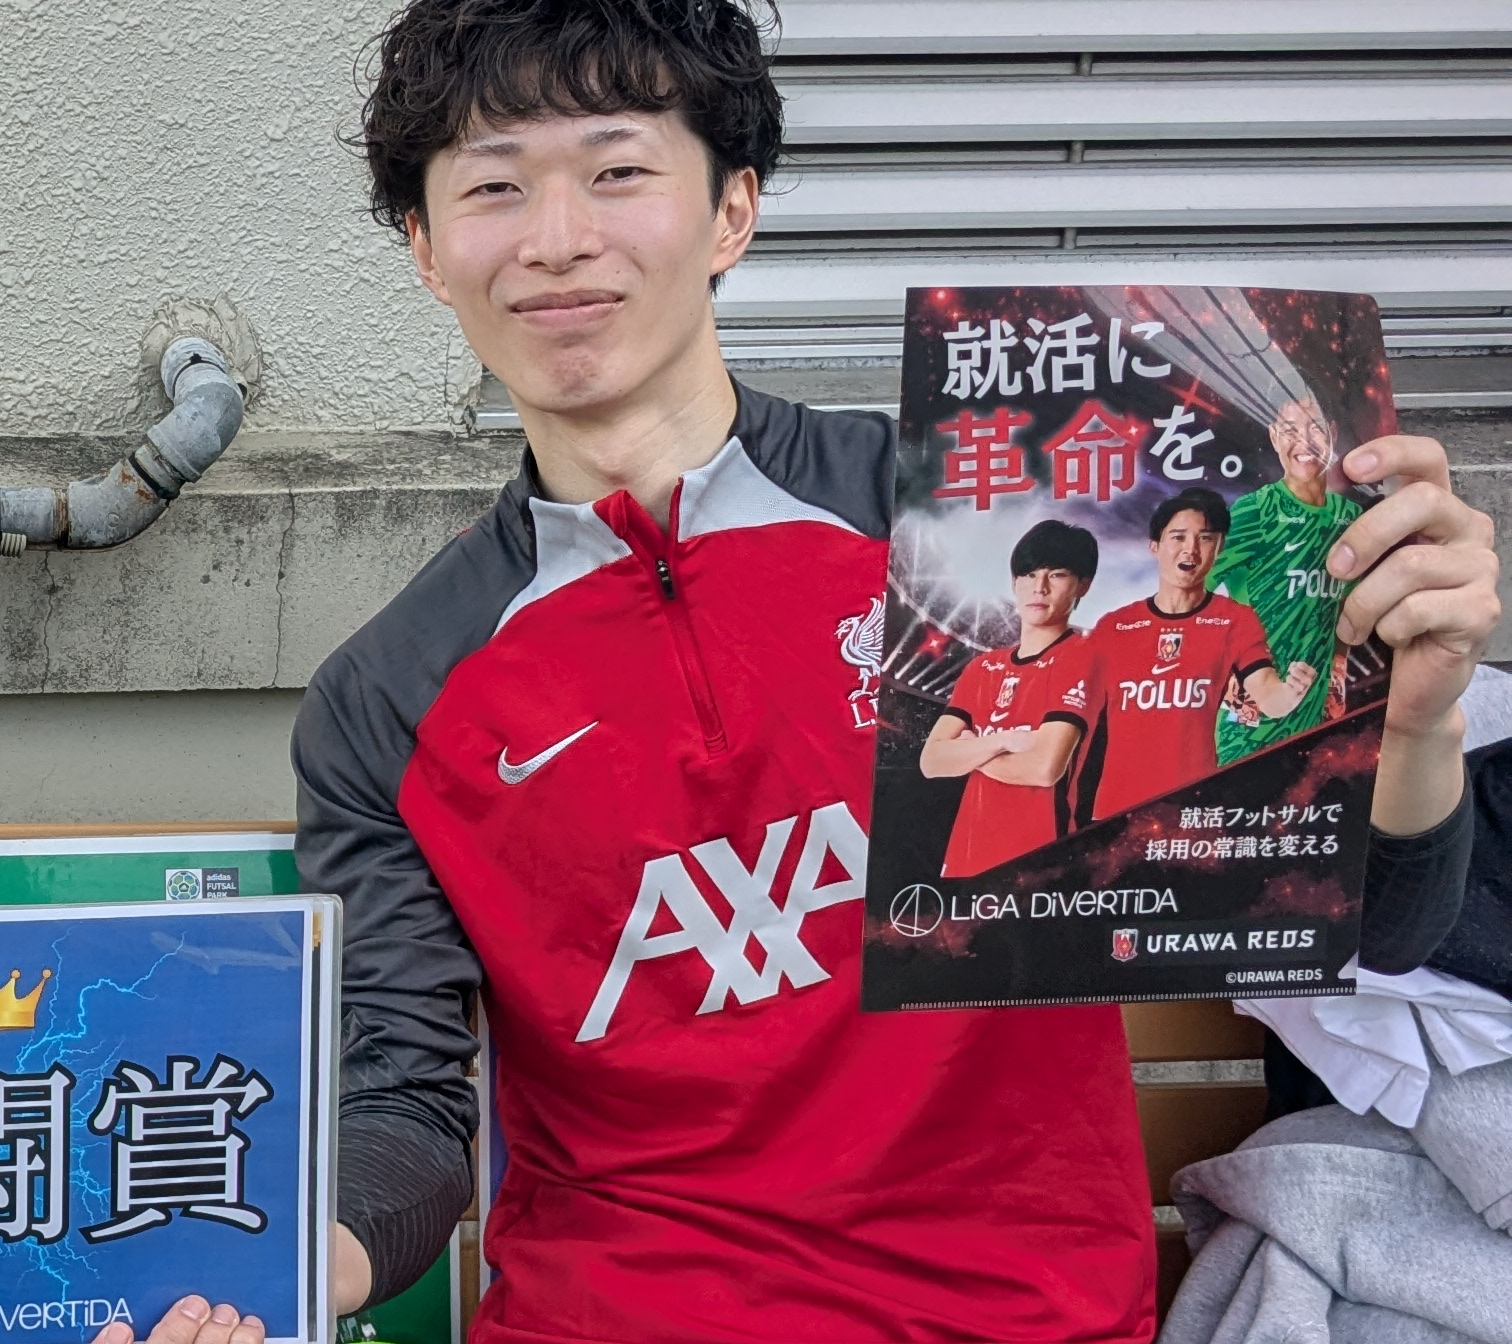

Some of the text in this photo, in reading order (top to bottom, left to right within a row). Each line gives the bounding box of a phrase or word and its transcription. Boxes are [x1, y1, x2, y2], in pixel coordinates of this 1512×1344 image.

[941, 312, 1172, 400] 就活に
[931, 399, 1243, 511] 革命を。
[1119, 678, 1212, 711] POLUS
[1178, 803, 1343, 830] 就活フットサルで
[1144, 834, 1340, 863] 採用の常識を変える
[206, 882, 237, 890] FUTSAL
[574, 801, 869, 1043] AXA
[1146, 929, 1317, 955] URAWA REDS
[1287, 967, 1324, 982] REDS
